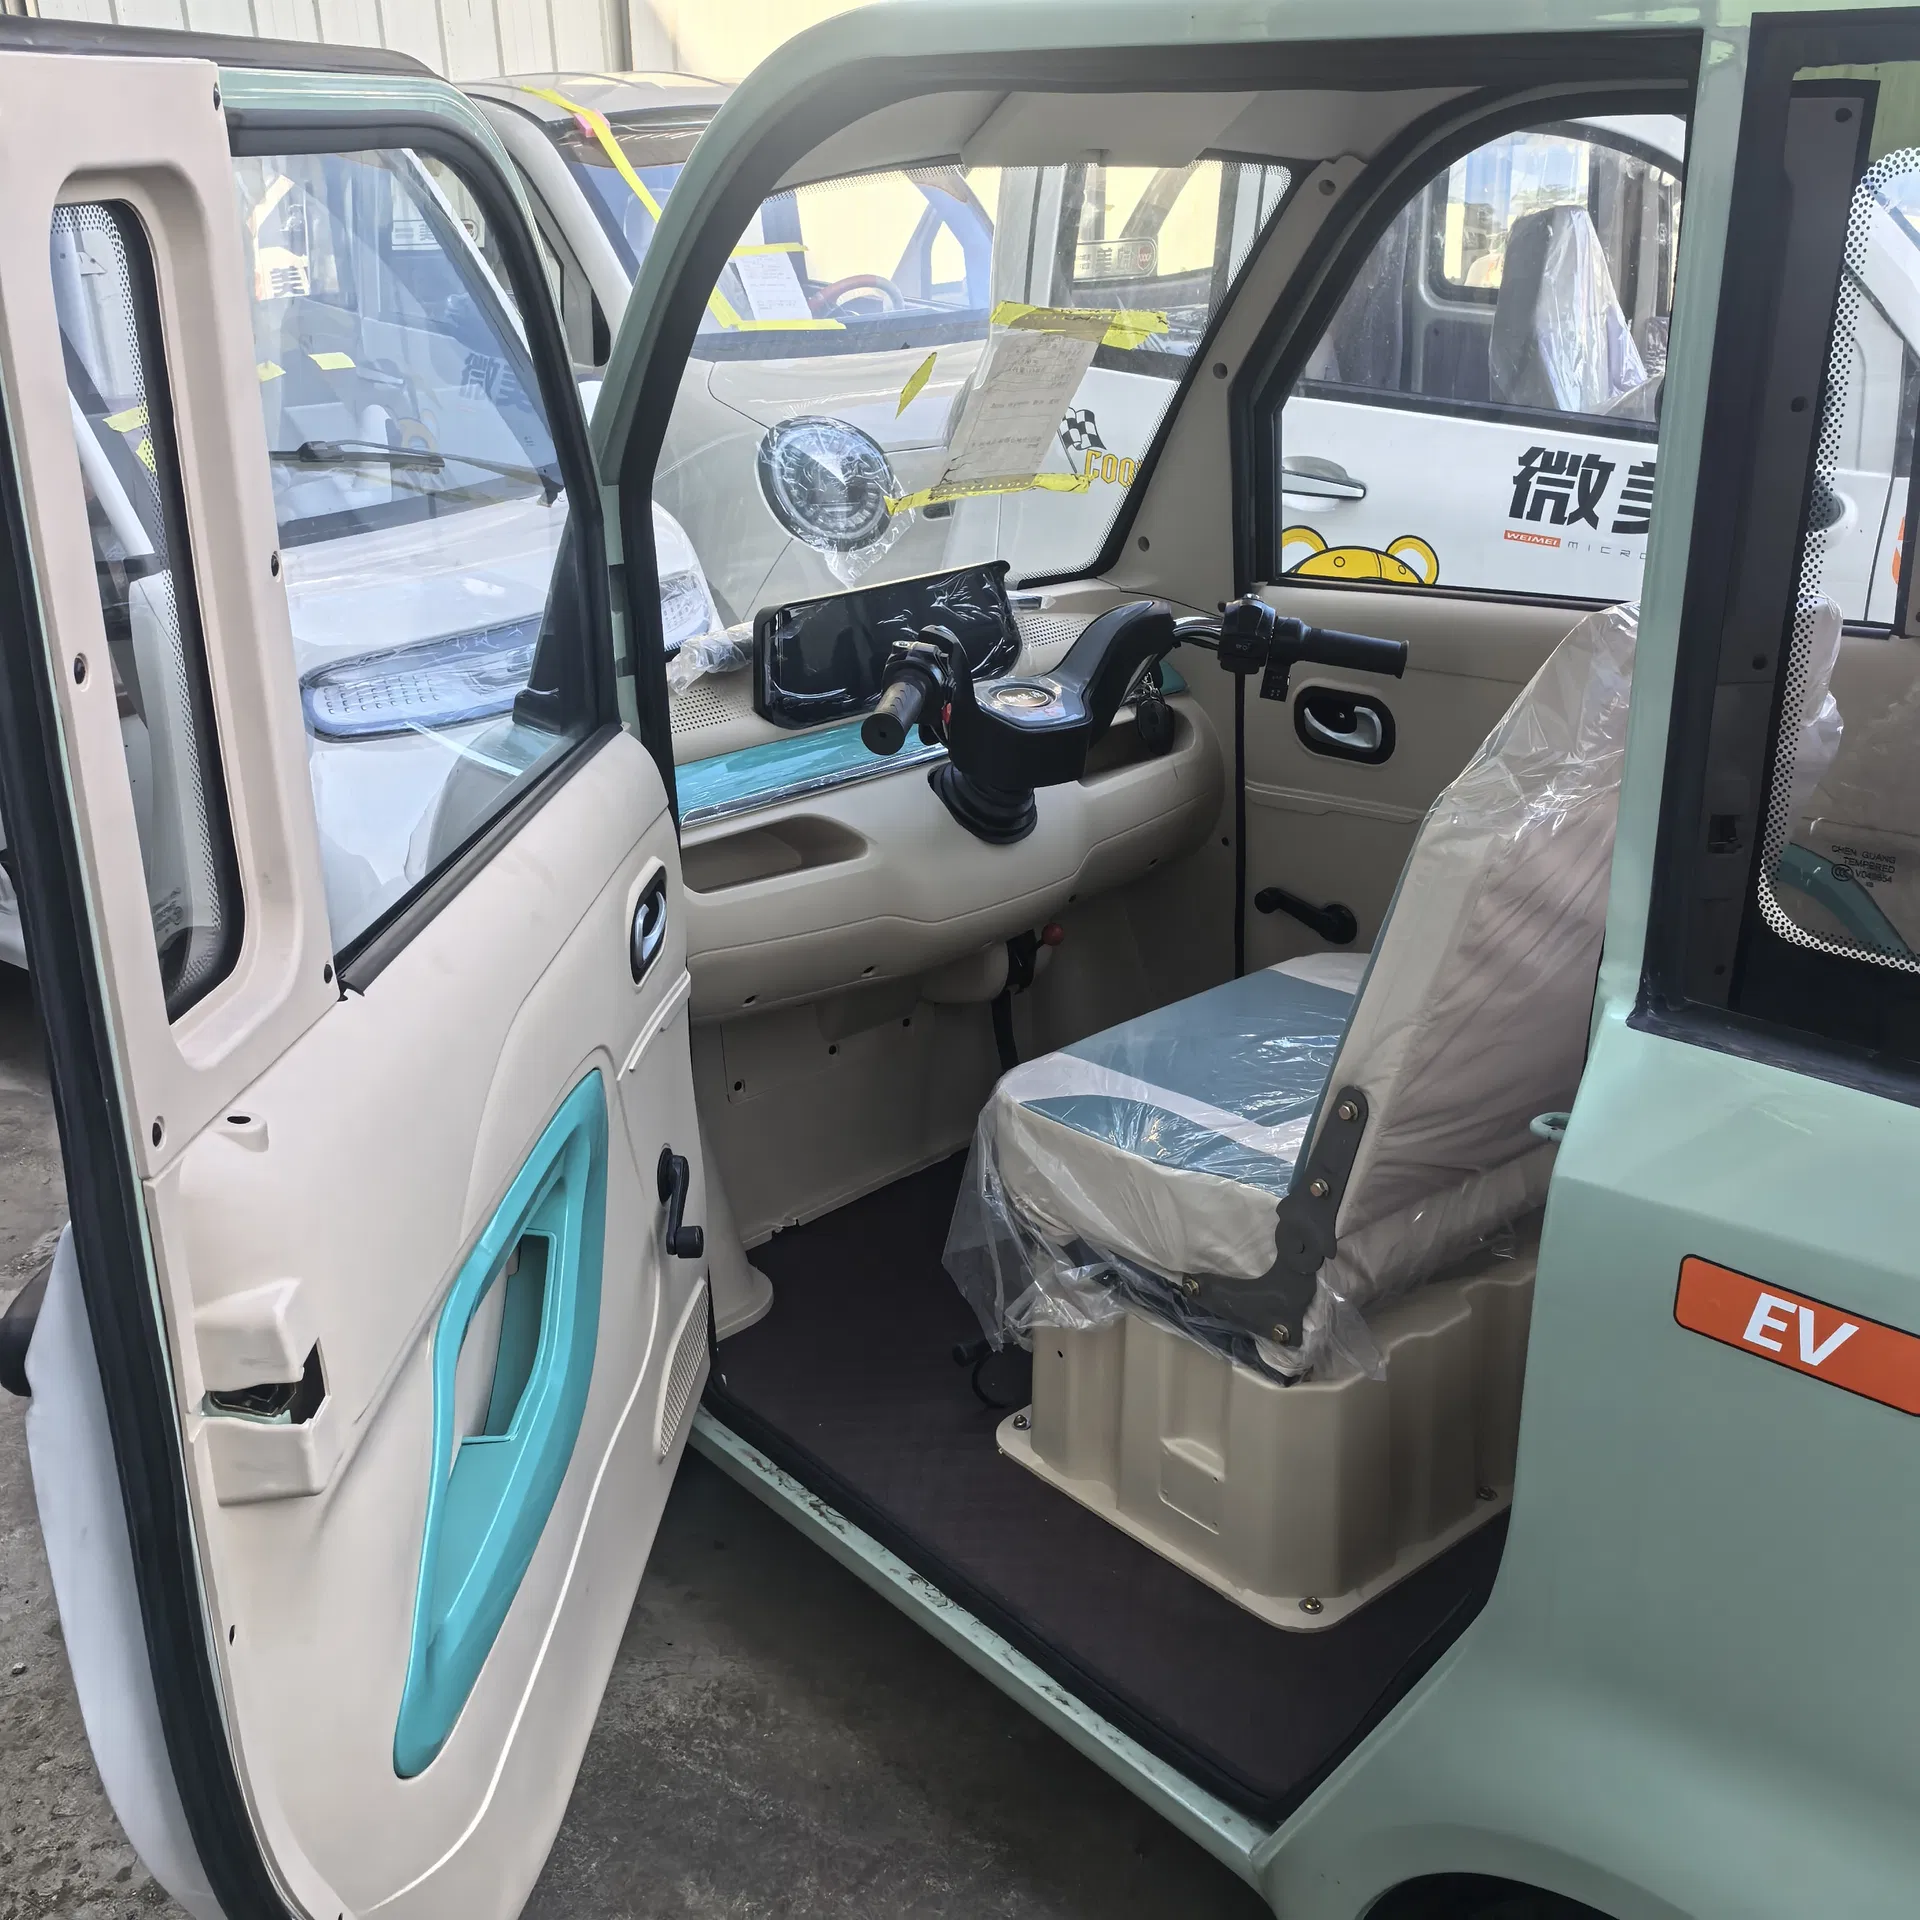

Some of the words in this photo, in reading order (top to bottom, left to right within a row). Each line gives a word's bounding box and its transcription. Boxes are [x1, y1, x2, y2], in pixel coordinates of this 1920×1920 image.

[1084, 449, 1140, 488] COO
[1506, 532, 1559, 546] WEIMEI
[1831, 845, 1857, 856] CHEN
[1861, 851, 1896, 864] GUANG
[1843, 857, 1896, 874] TEMPERED
[1743, 1292, 1860, 1366] EV
